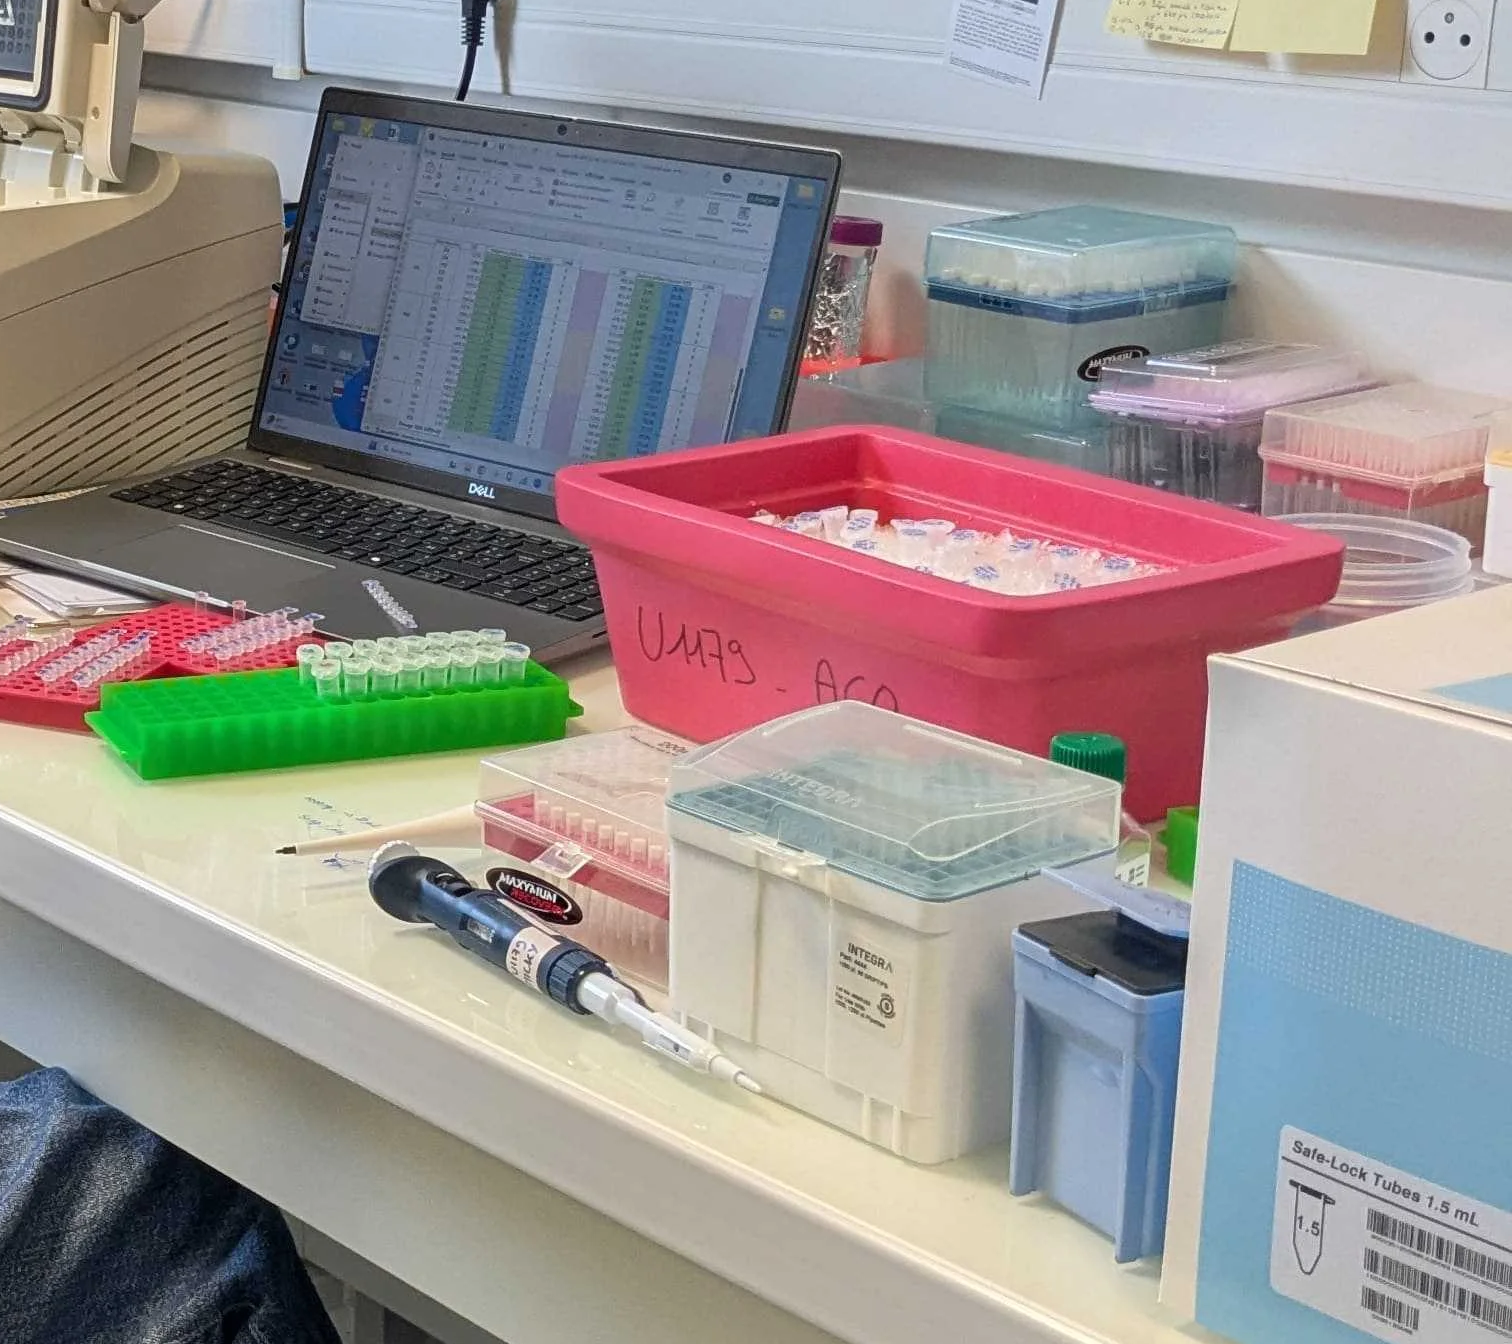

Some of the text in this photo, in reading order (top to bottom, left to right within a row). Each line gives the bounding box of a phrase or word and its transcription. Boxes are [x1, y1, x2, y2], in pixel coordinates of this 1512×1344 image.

[468, 483, 495, 499] DELL
[639, 606, 755, 684] U1179
[499, 872, 557, 903] MAXYMUM
[848, 942, 893, 973] INTEGRA
[1292, 1140, 1480, 1227] Safe-Lock Tubes 1.5 mL
[1297, 1215, 1320, 1236] 1.5
